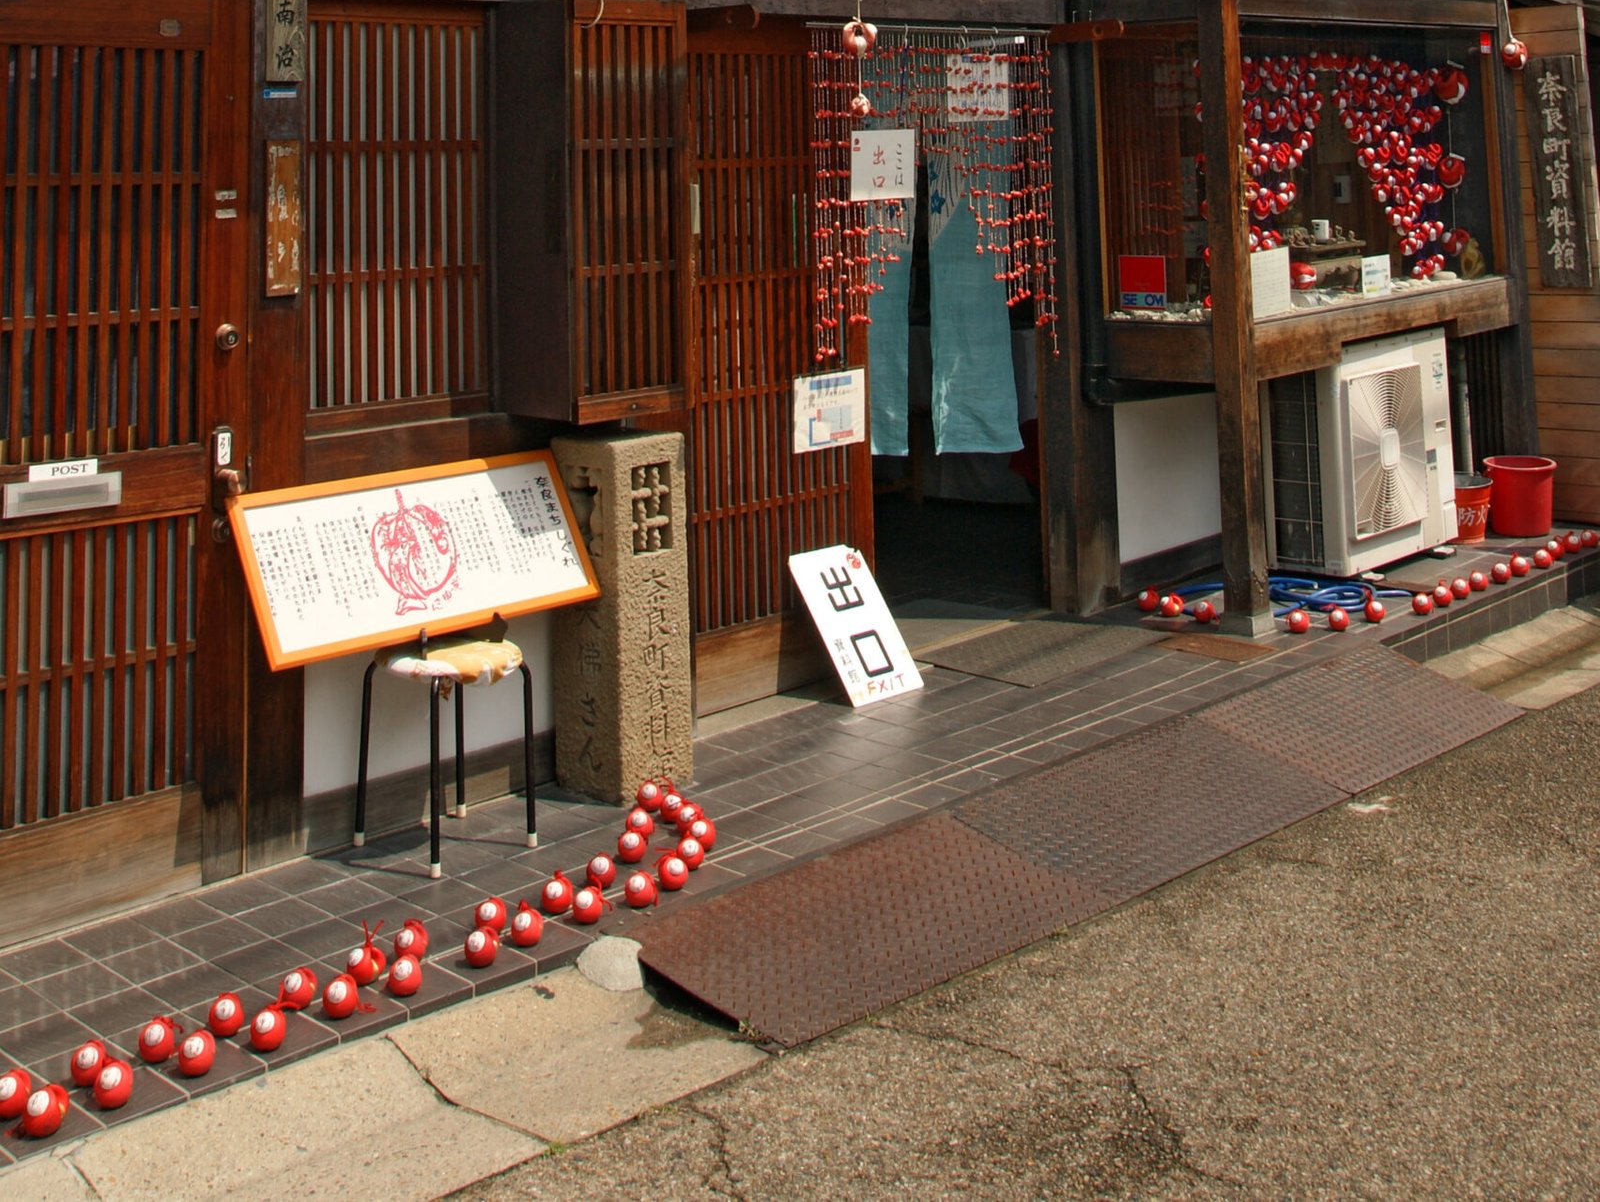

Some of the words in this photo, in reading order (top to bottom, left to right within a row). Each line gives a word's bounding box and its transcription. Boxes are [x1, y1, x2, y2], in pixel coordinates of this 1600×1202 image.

[872, 143, 887, 189] 出口
[894, 142, 904, 187] ここは
[1537, 71, 1578, 271] 奈良町資料館
[51, 463, 89, 477] POST
[1457, 504, 1487, 527] 防火
[820, 565, 895, 678] 出口
